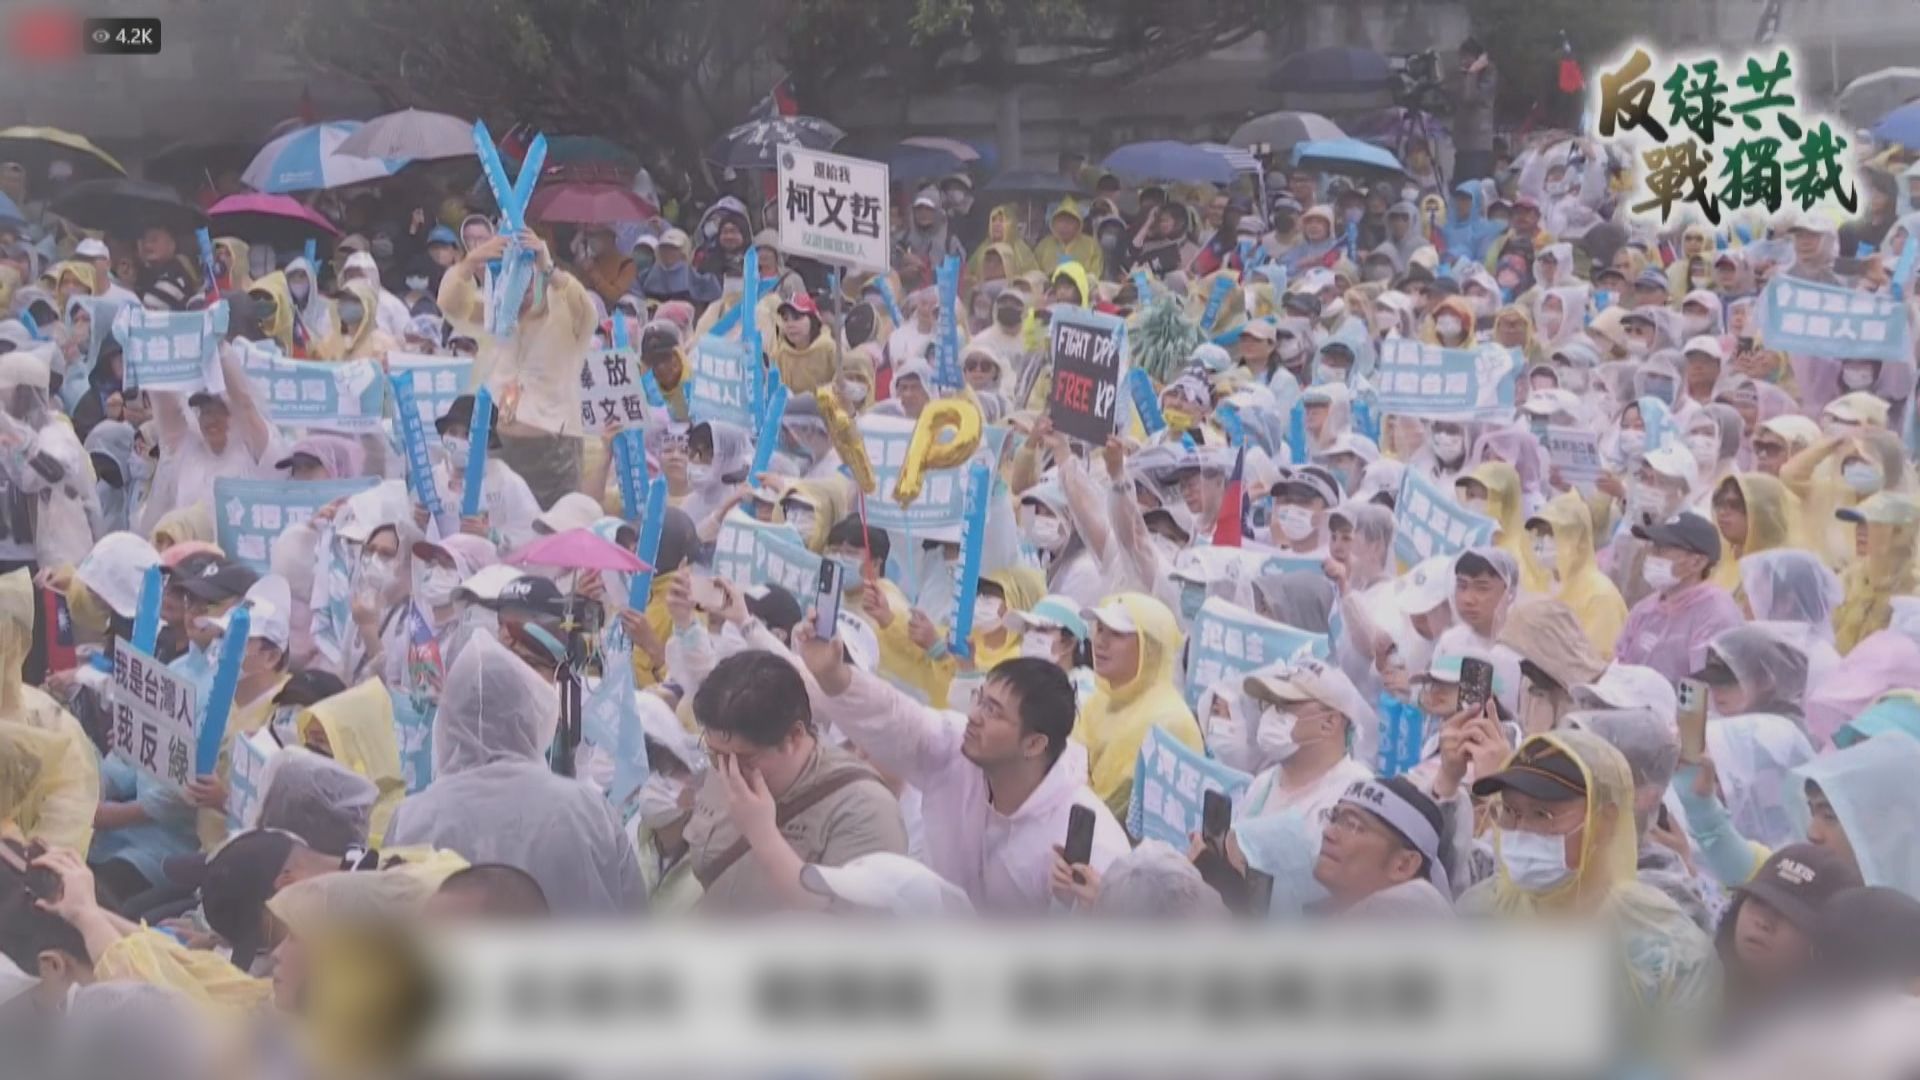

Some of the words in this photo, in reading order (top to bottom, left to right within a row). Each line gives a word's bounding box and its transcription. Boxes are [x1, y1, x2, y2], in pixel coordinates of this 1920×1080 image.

[786, 177, 882, 239] 柯文哲
[1057, 325, 1092, 362] FIGHT
[1092, 333, 1117, 368] DPP
[1055, 369, 1094, 414] FREE
[1094, 379, 1116, 419] KP
[115, 648, 193, 729] 我是台灣人
[117, 703, 190, 786] 我反綠
